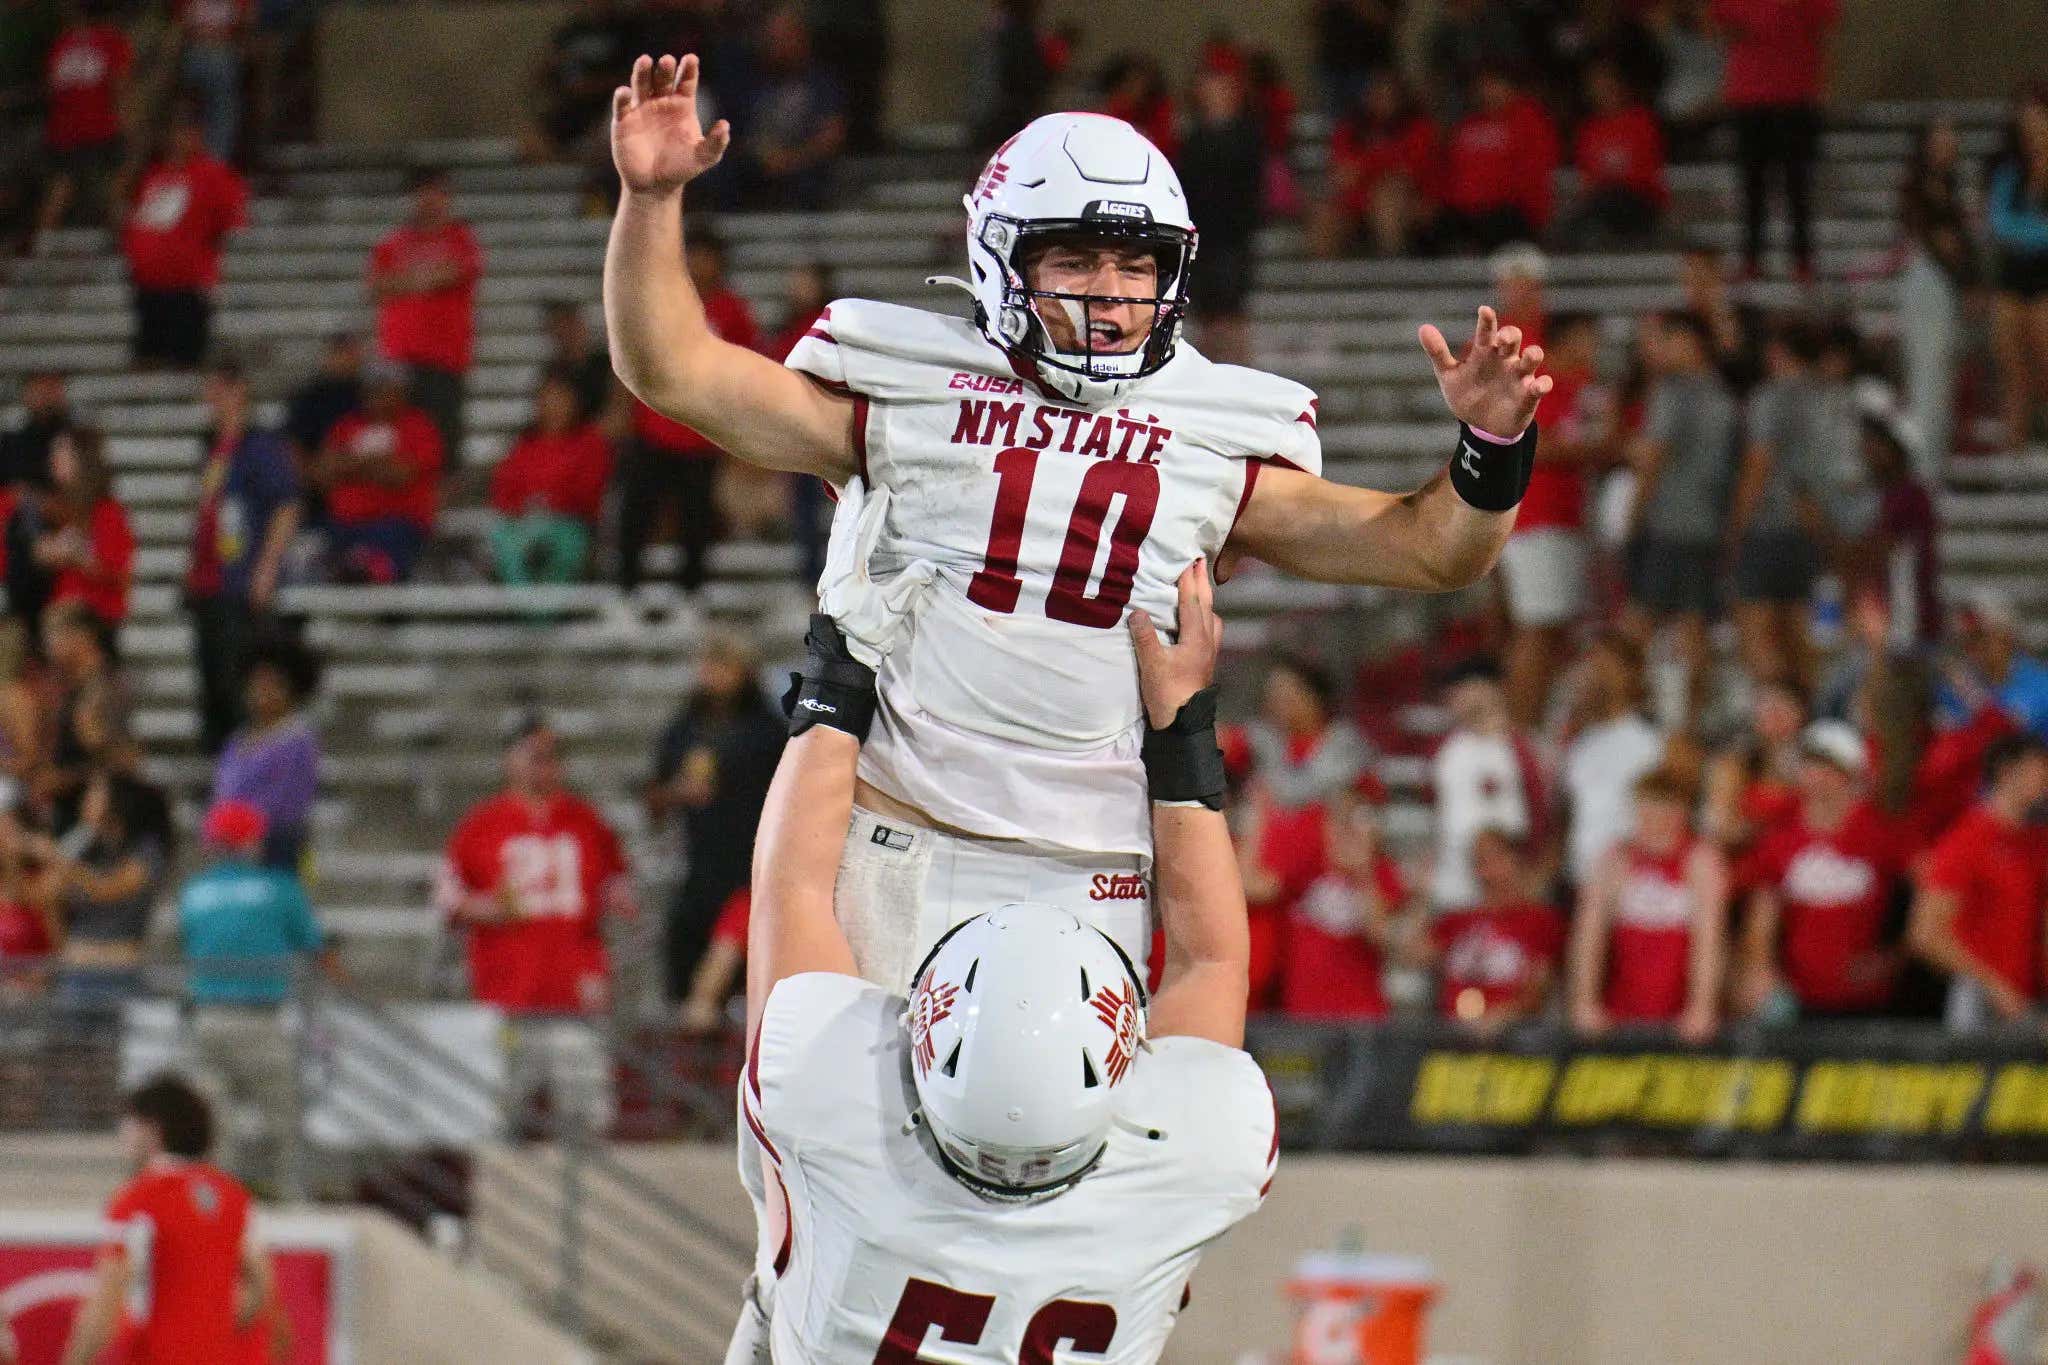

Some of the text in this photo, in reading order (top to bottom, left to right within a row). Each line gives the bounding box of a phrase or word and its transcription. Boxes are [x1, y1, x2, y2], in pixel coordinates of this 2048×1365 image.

[1081, 363, 1119, 373] Rddell
[951, 399, 1172, 465] NM STATE
[966, 447, 1160, 629] 10
